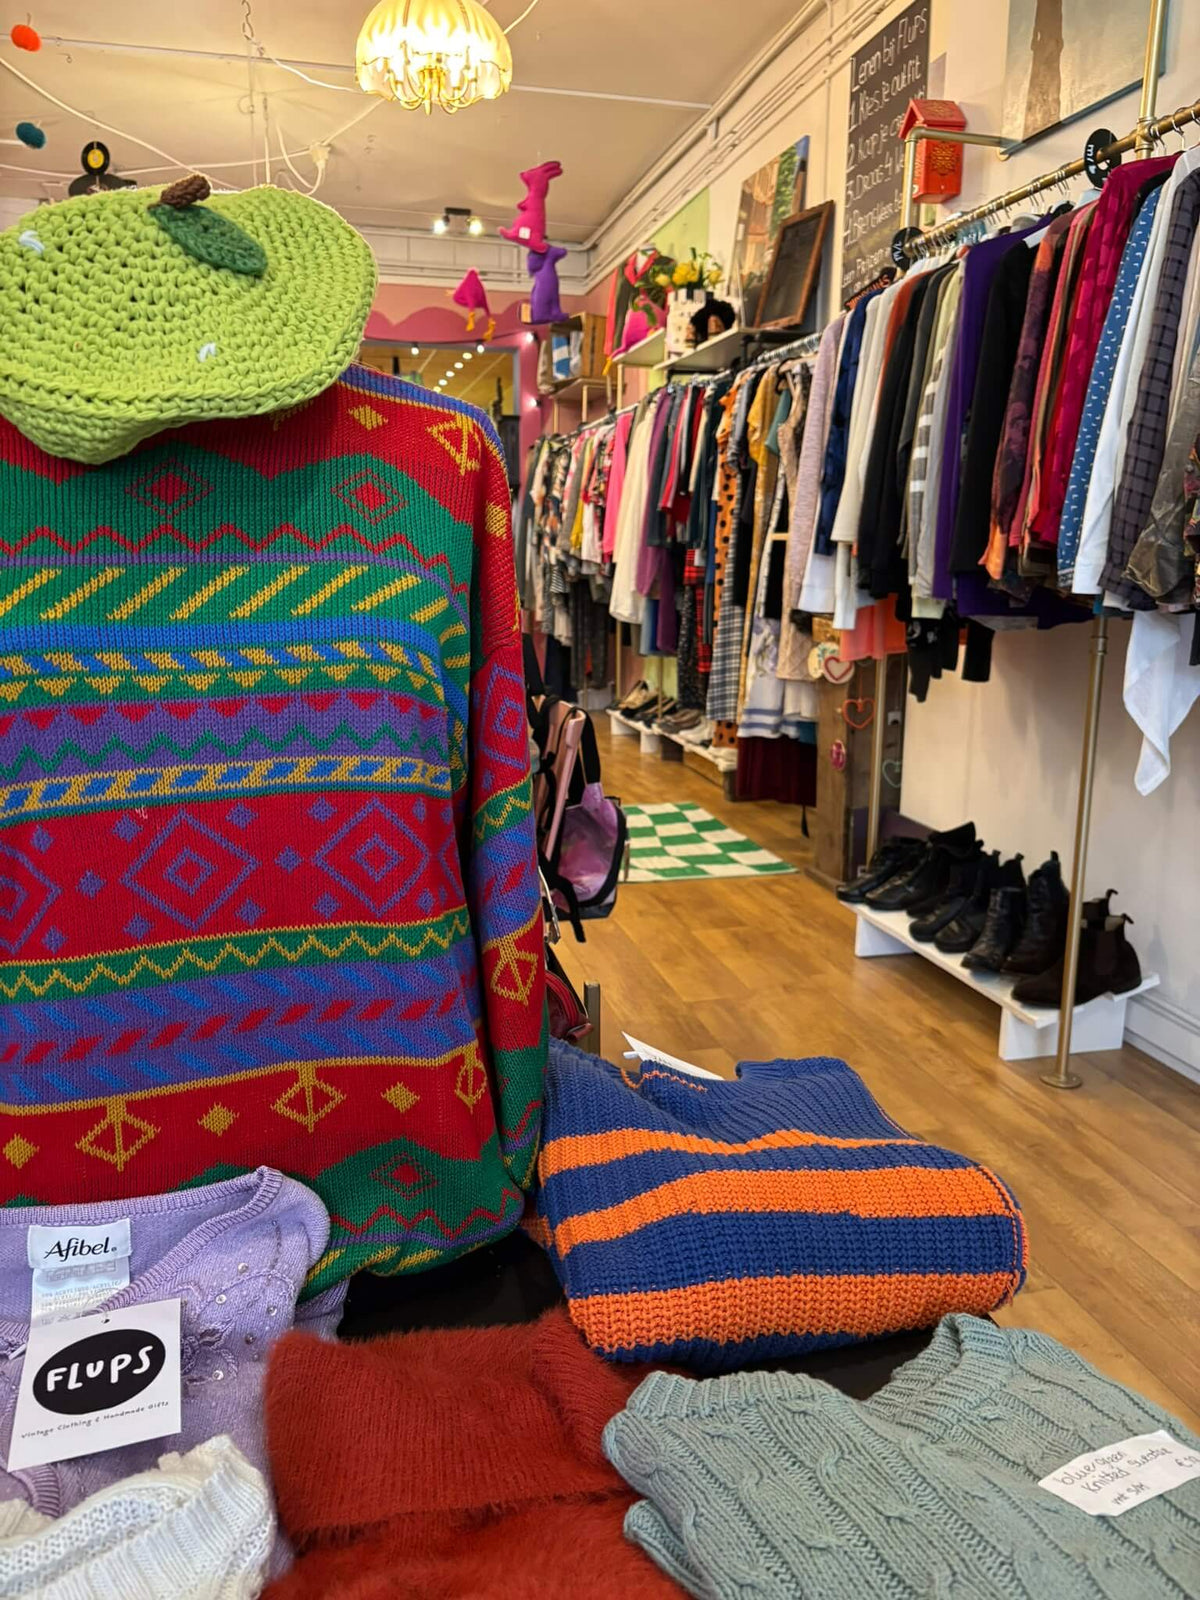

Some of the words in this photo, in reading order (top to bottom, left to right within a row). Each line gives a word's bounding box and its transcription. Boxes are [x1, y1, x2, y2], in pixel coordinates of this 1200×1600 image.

[44, 1237, 110, 1262] Afibel
[46, 1346, 153, 1392] FLUPS
[21, 1427, 54, 1439] Vintage
[57, 1414, 92, 1427] Clothing
[103, 1407, 145, 1420] Handmade
[148, 1401, 169, 1410] Gifts
